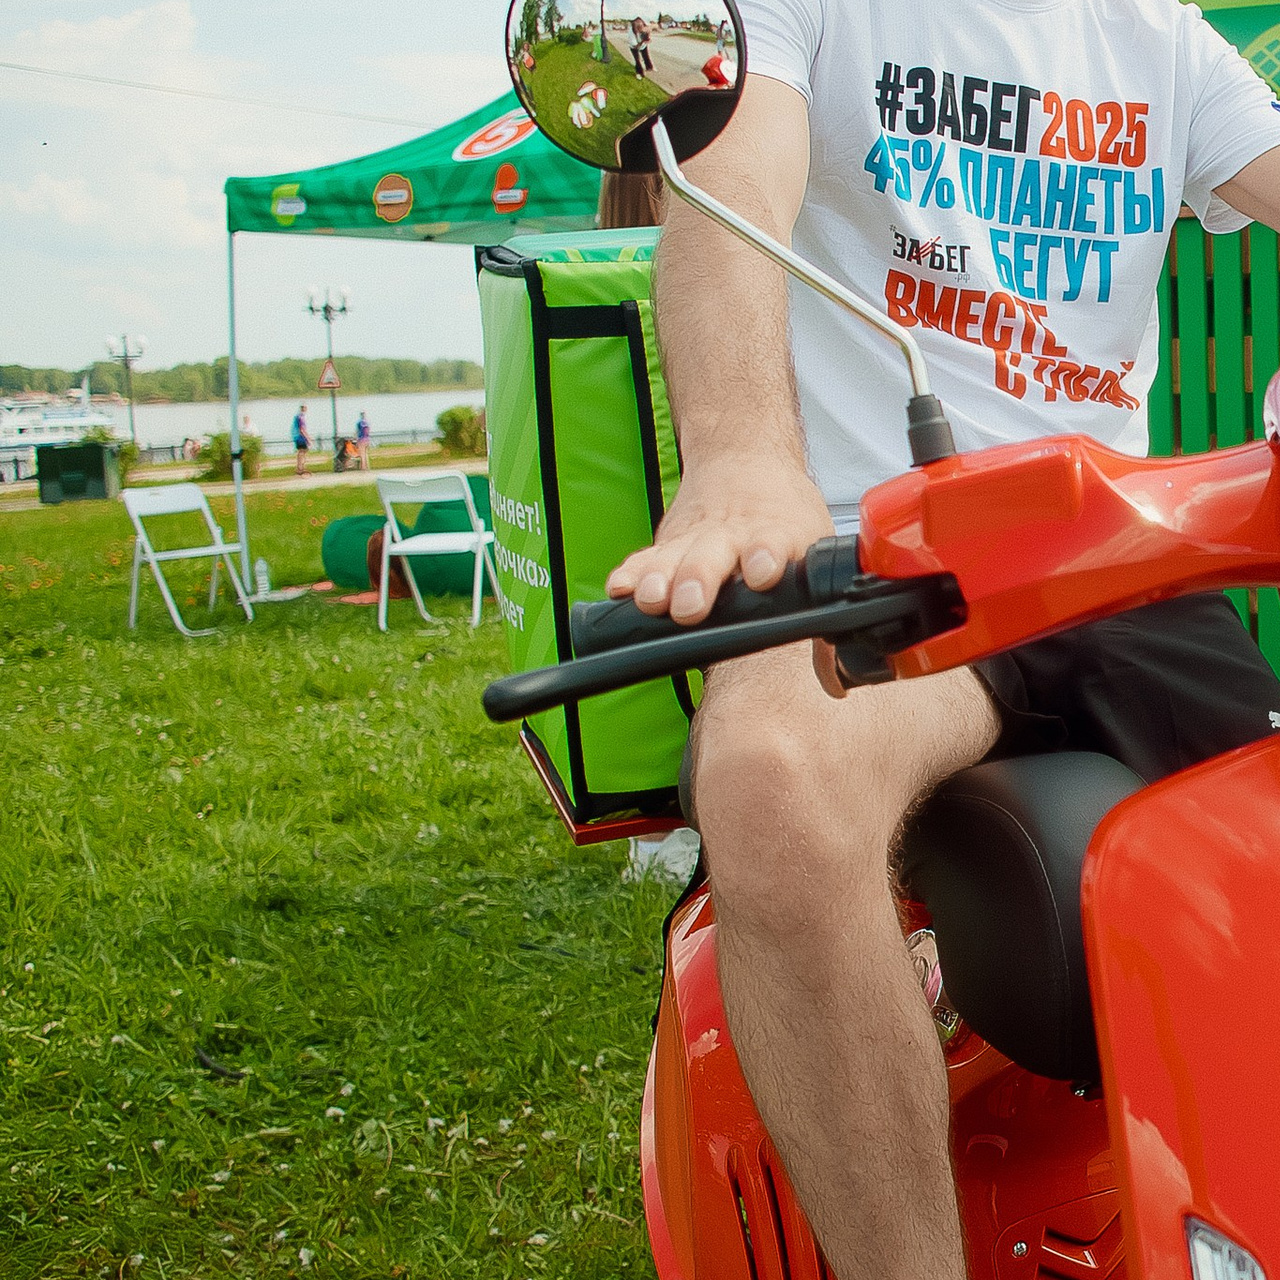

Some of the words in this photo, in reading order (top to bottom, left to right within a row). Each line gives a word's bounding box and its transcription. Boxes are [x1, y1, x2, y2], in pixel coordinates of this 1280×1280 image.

[864, 129, 955, 209] 45%
[959, 147, 1165, 235] ПЛАНЕТЫ
[989, 227, 1119, 303] БЕГУТ
